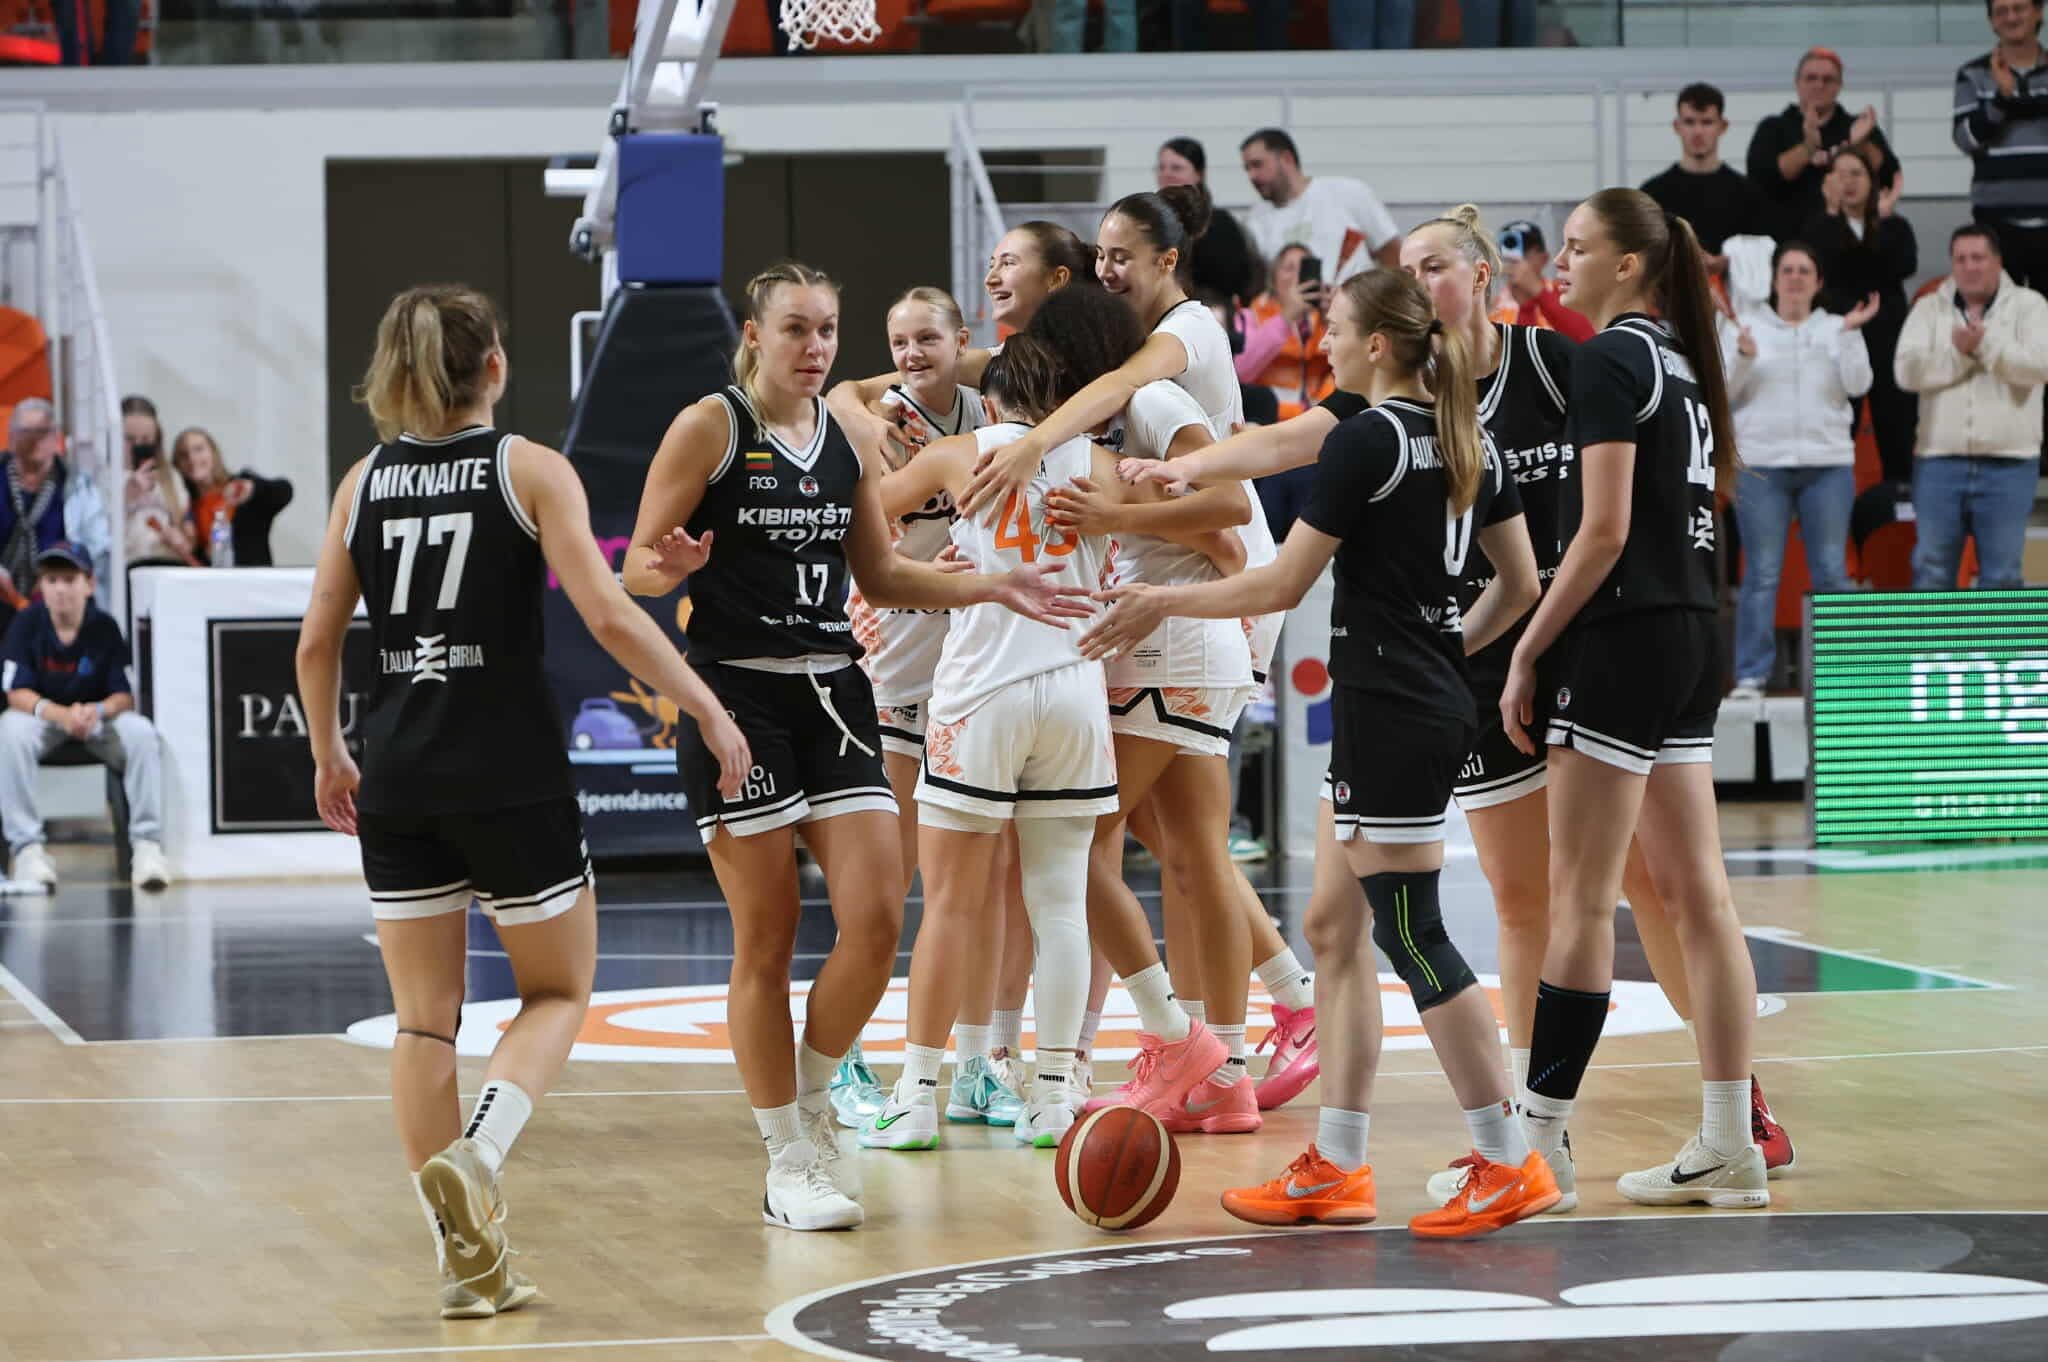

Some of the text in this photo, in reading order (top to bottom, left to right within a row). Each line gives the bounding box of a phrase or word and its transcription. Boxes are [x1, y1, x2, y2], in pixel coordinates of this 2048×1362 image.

[1683, 397, 1716, 492] 12
[369, 458, 491, 502] MIKNAITE
[737, 502, 853, 525] KIBIRKŠTI
[382, 512, 473, 615] 77
[795, 563, 829, 607] 17
[449, 645, 485, 668] GIRIA
